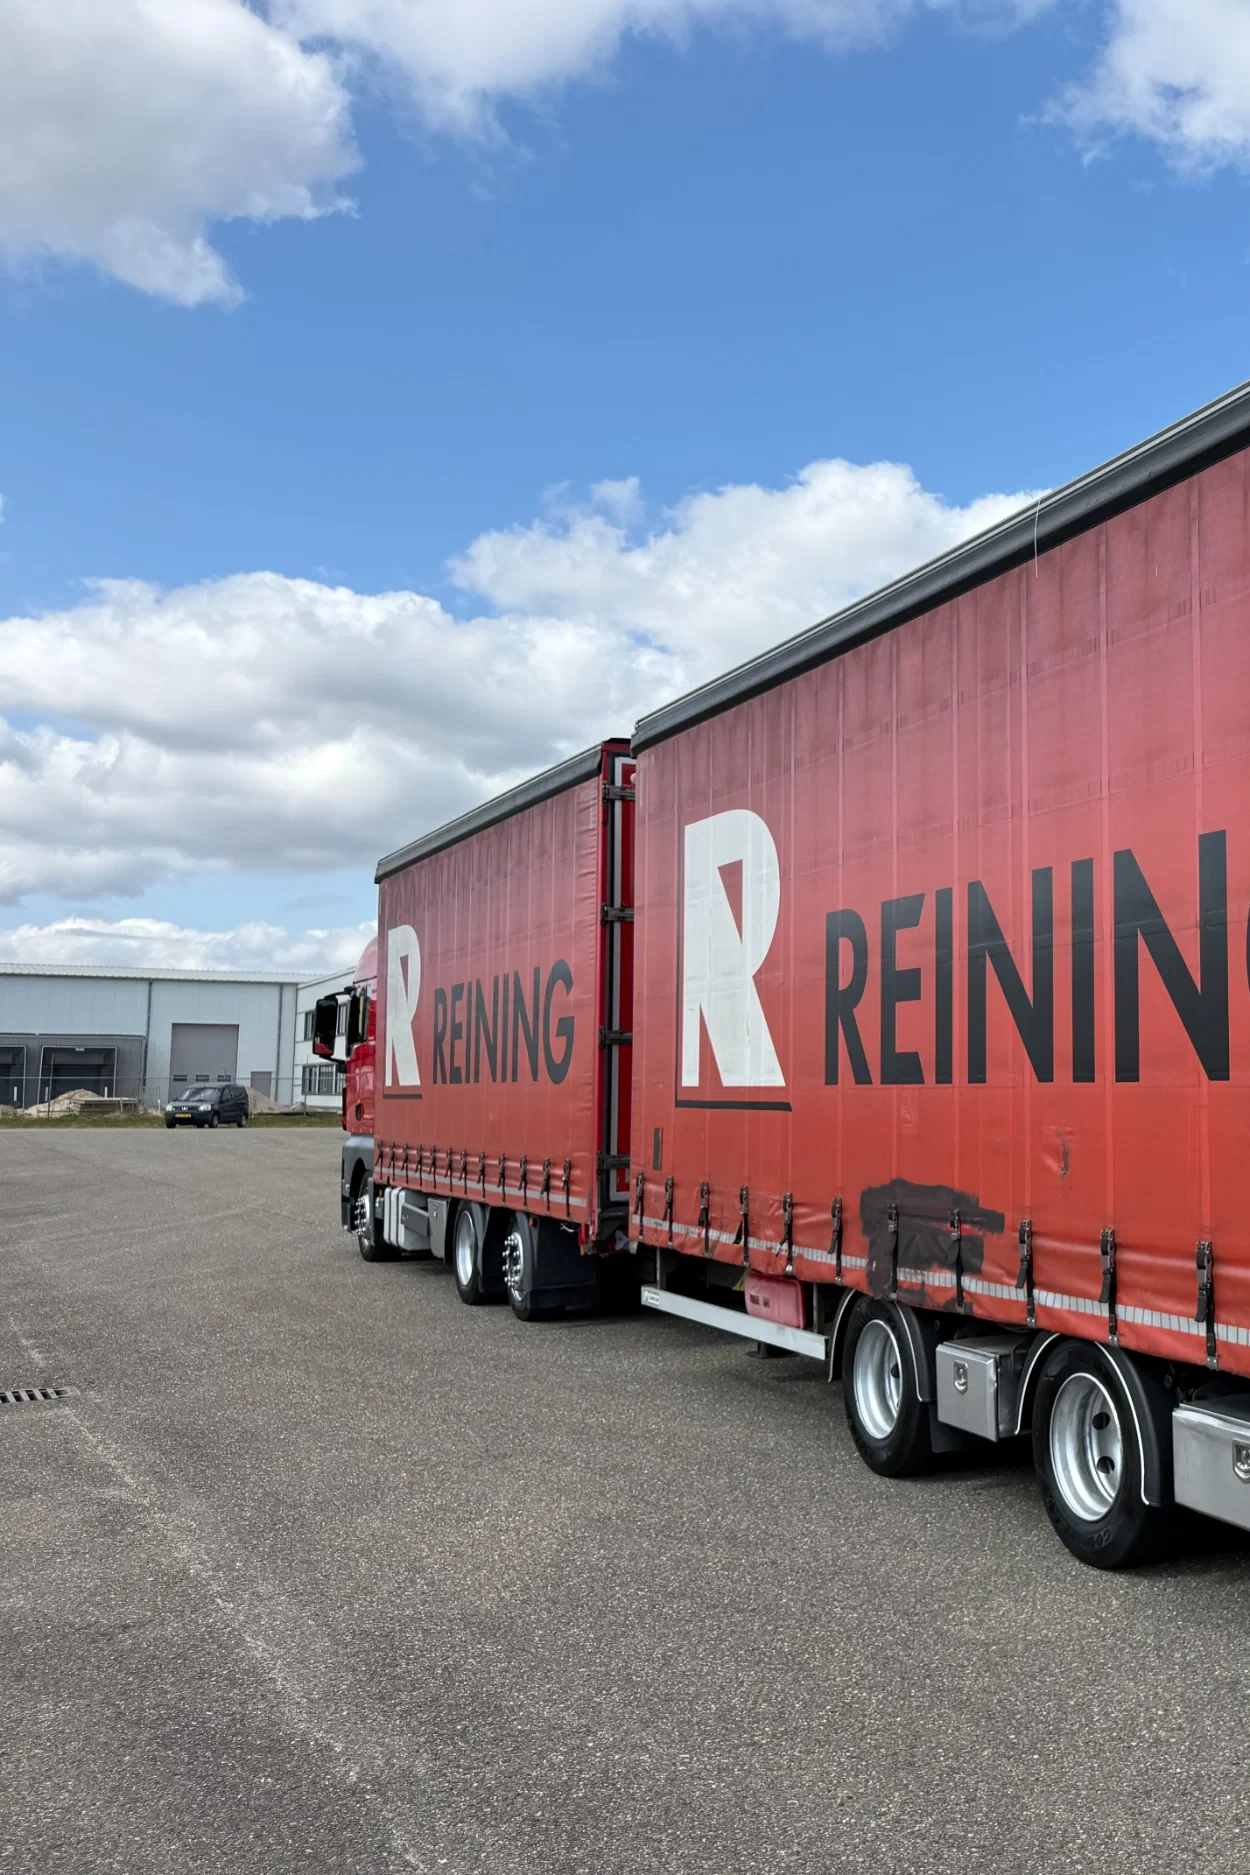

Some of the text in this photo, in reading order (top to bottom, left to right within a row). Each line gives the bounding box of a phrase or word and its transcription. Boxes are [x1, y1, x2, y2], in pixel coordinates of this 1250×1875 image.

[385, 924, 575, 1087] R REINING
[681, 808, 787, 1088] R
